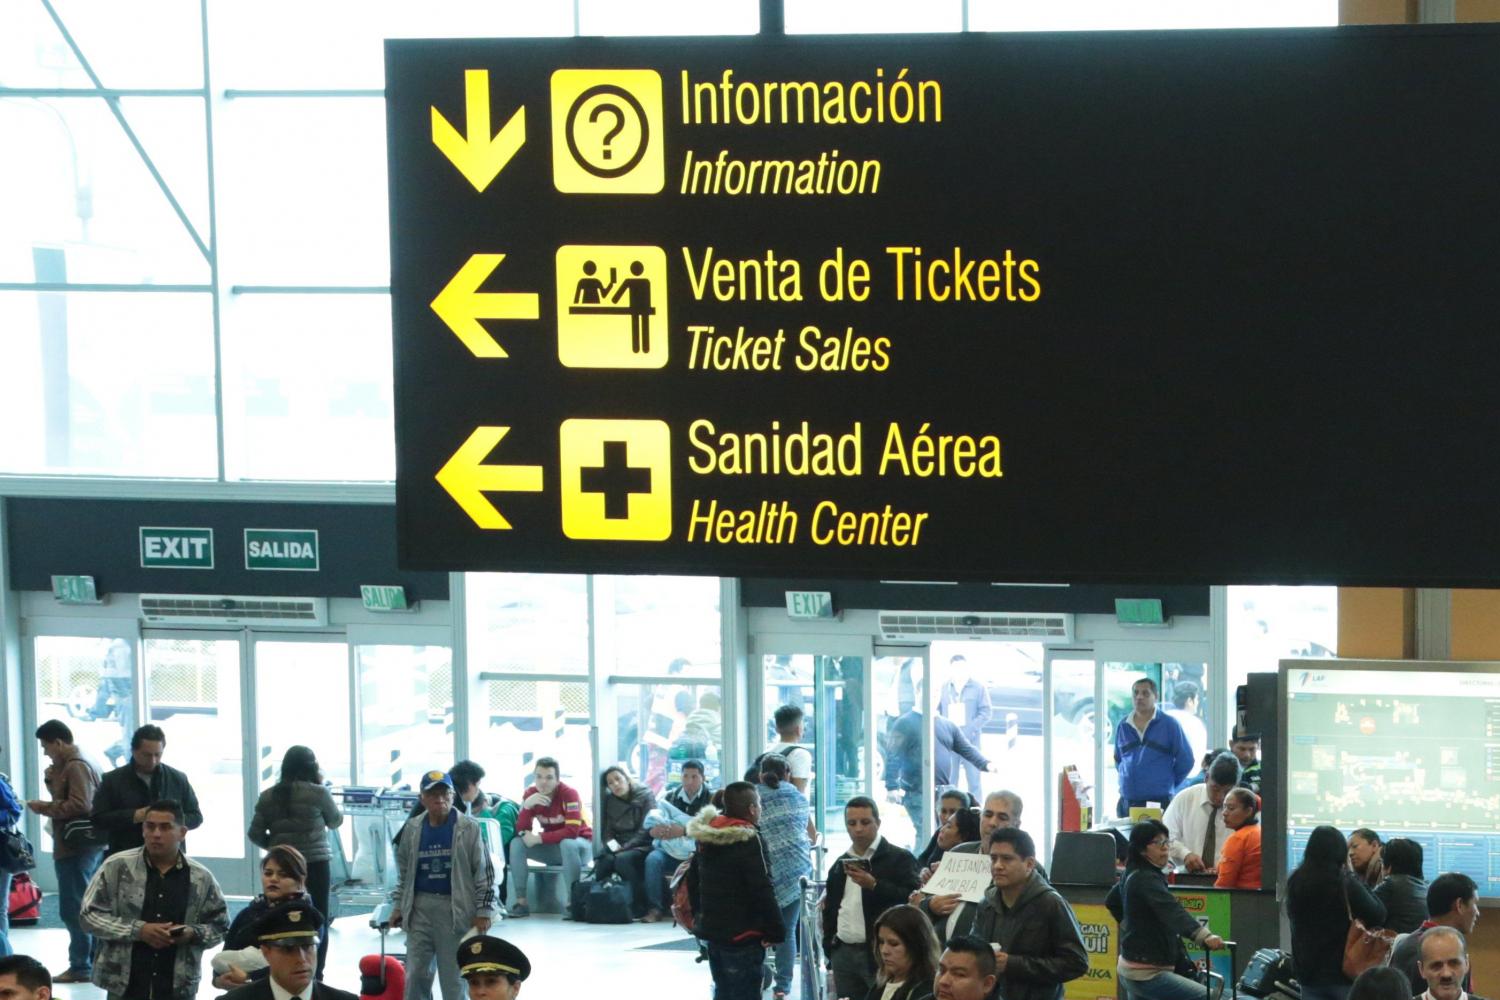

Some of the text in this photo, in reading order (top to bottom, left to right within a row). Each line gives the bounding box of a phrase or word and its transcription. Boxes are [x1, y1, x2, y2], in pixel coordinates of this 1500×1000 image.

[682, 68, 942, 124] Información
[680, 150, 881, 195] Information
[682, 247, 1041, 302] Venta de Tickets
[687, 326, 891, 372] Ticket Sales
[688, 419, 1004, 478] Sanidad Aérea
[688, 500, 929, 547] Health Center
[144, 537, 208, 559] EXIT
[249, 541, 314, 559] SALIDA
[793, 594, 825, 614] EXIT
[944, 858, 991, 874] ALEJANDR
